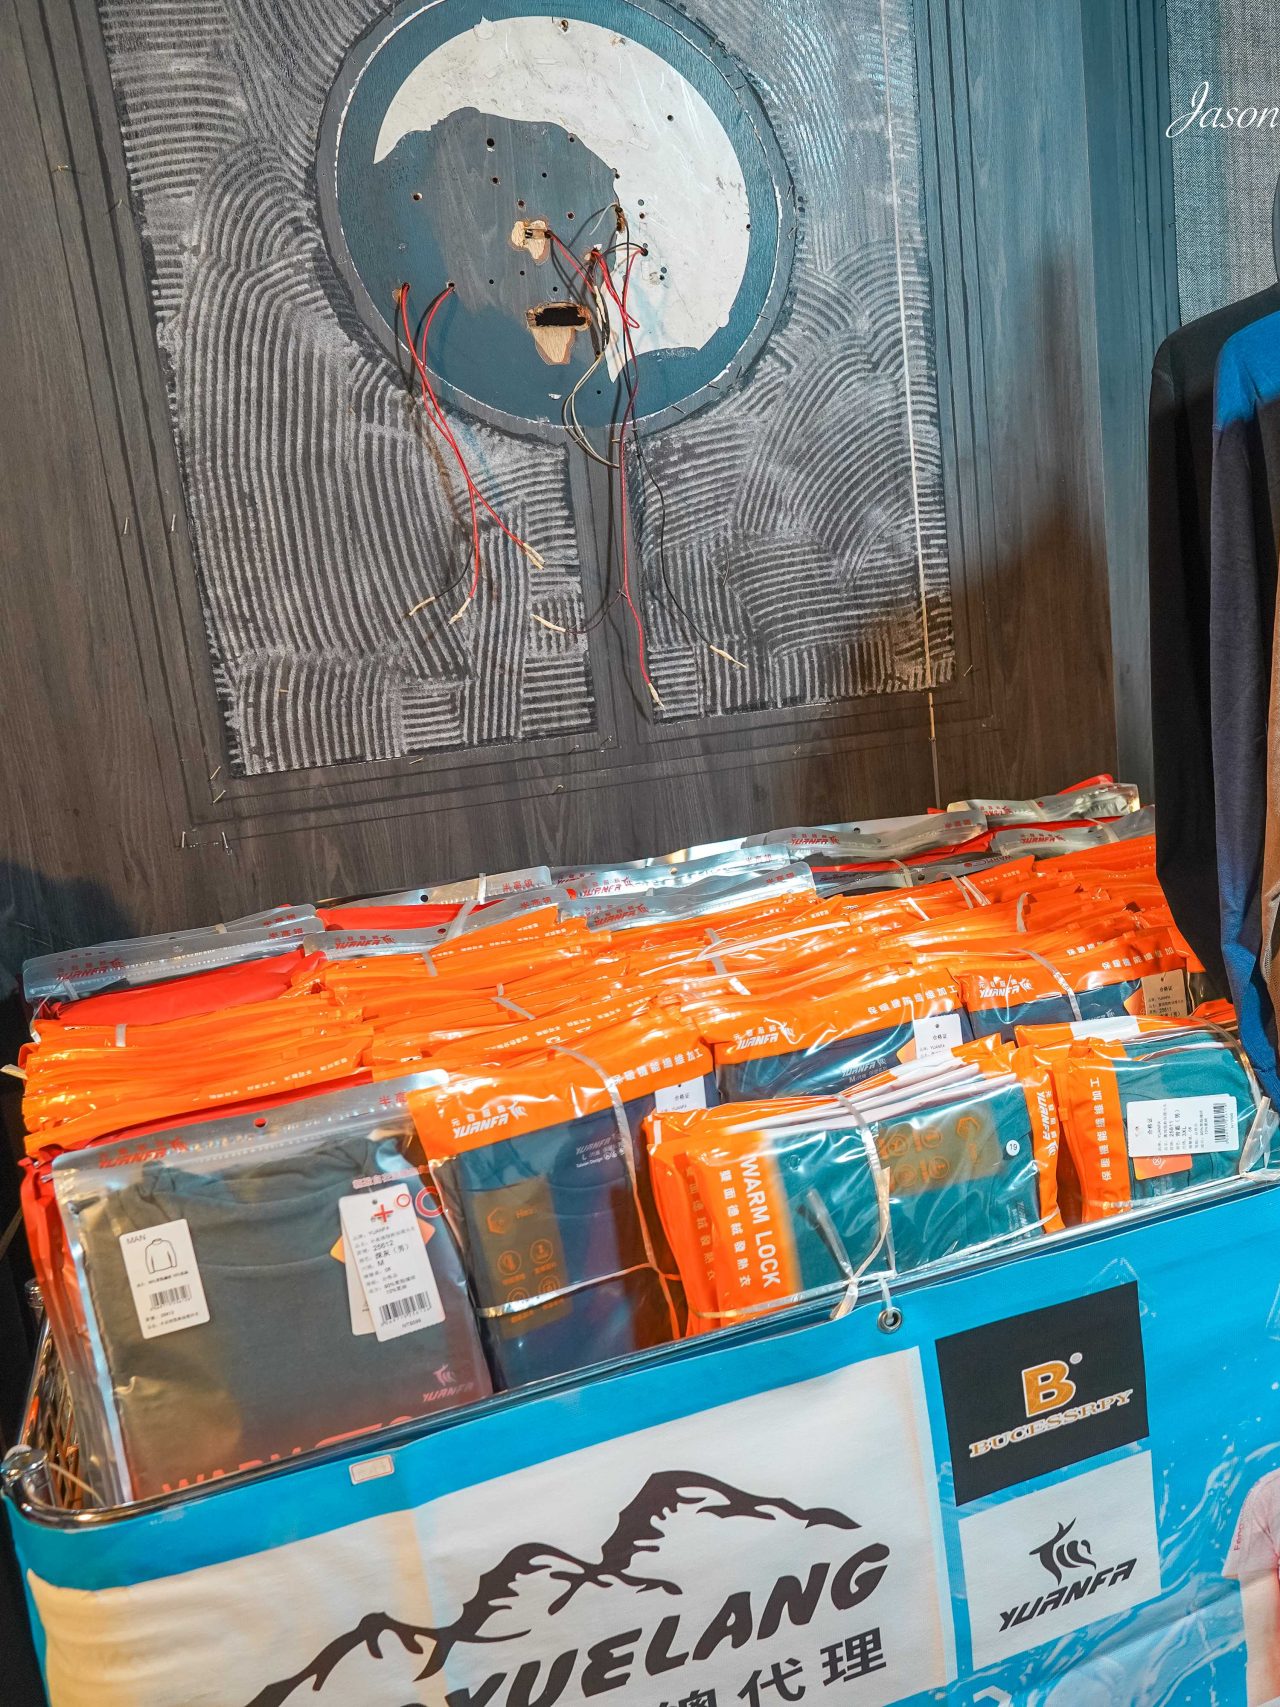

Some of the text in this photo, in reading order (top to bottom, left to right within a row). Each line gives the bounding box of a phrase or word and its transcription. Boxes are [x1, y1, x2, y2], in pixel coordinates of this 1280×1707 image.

[736, 1033, 779, 1050] YUANFA
[452, 1112, 509, 1139] YUANFA
[1037, 1091, 1052, 1140] YUANFA
[126, 1234, 146, 1245] MAN
[740, 1154, 781, 1289] WARM LOCK
[1021, 1359, 1077, 1419] B
[968, 1388, 1134, 1458] BUCESSRPY
[998, 1557, 1138, 1633] YUANFA
